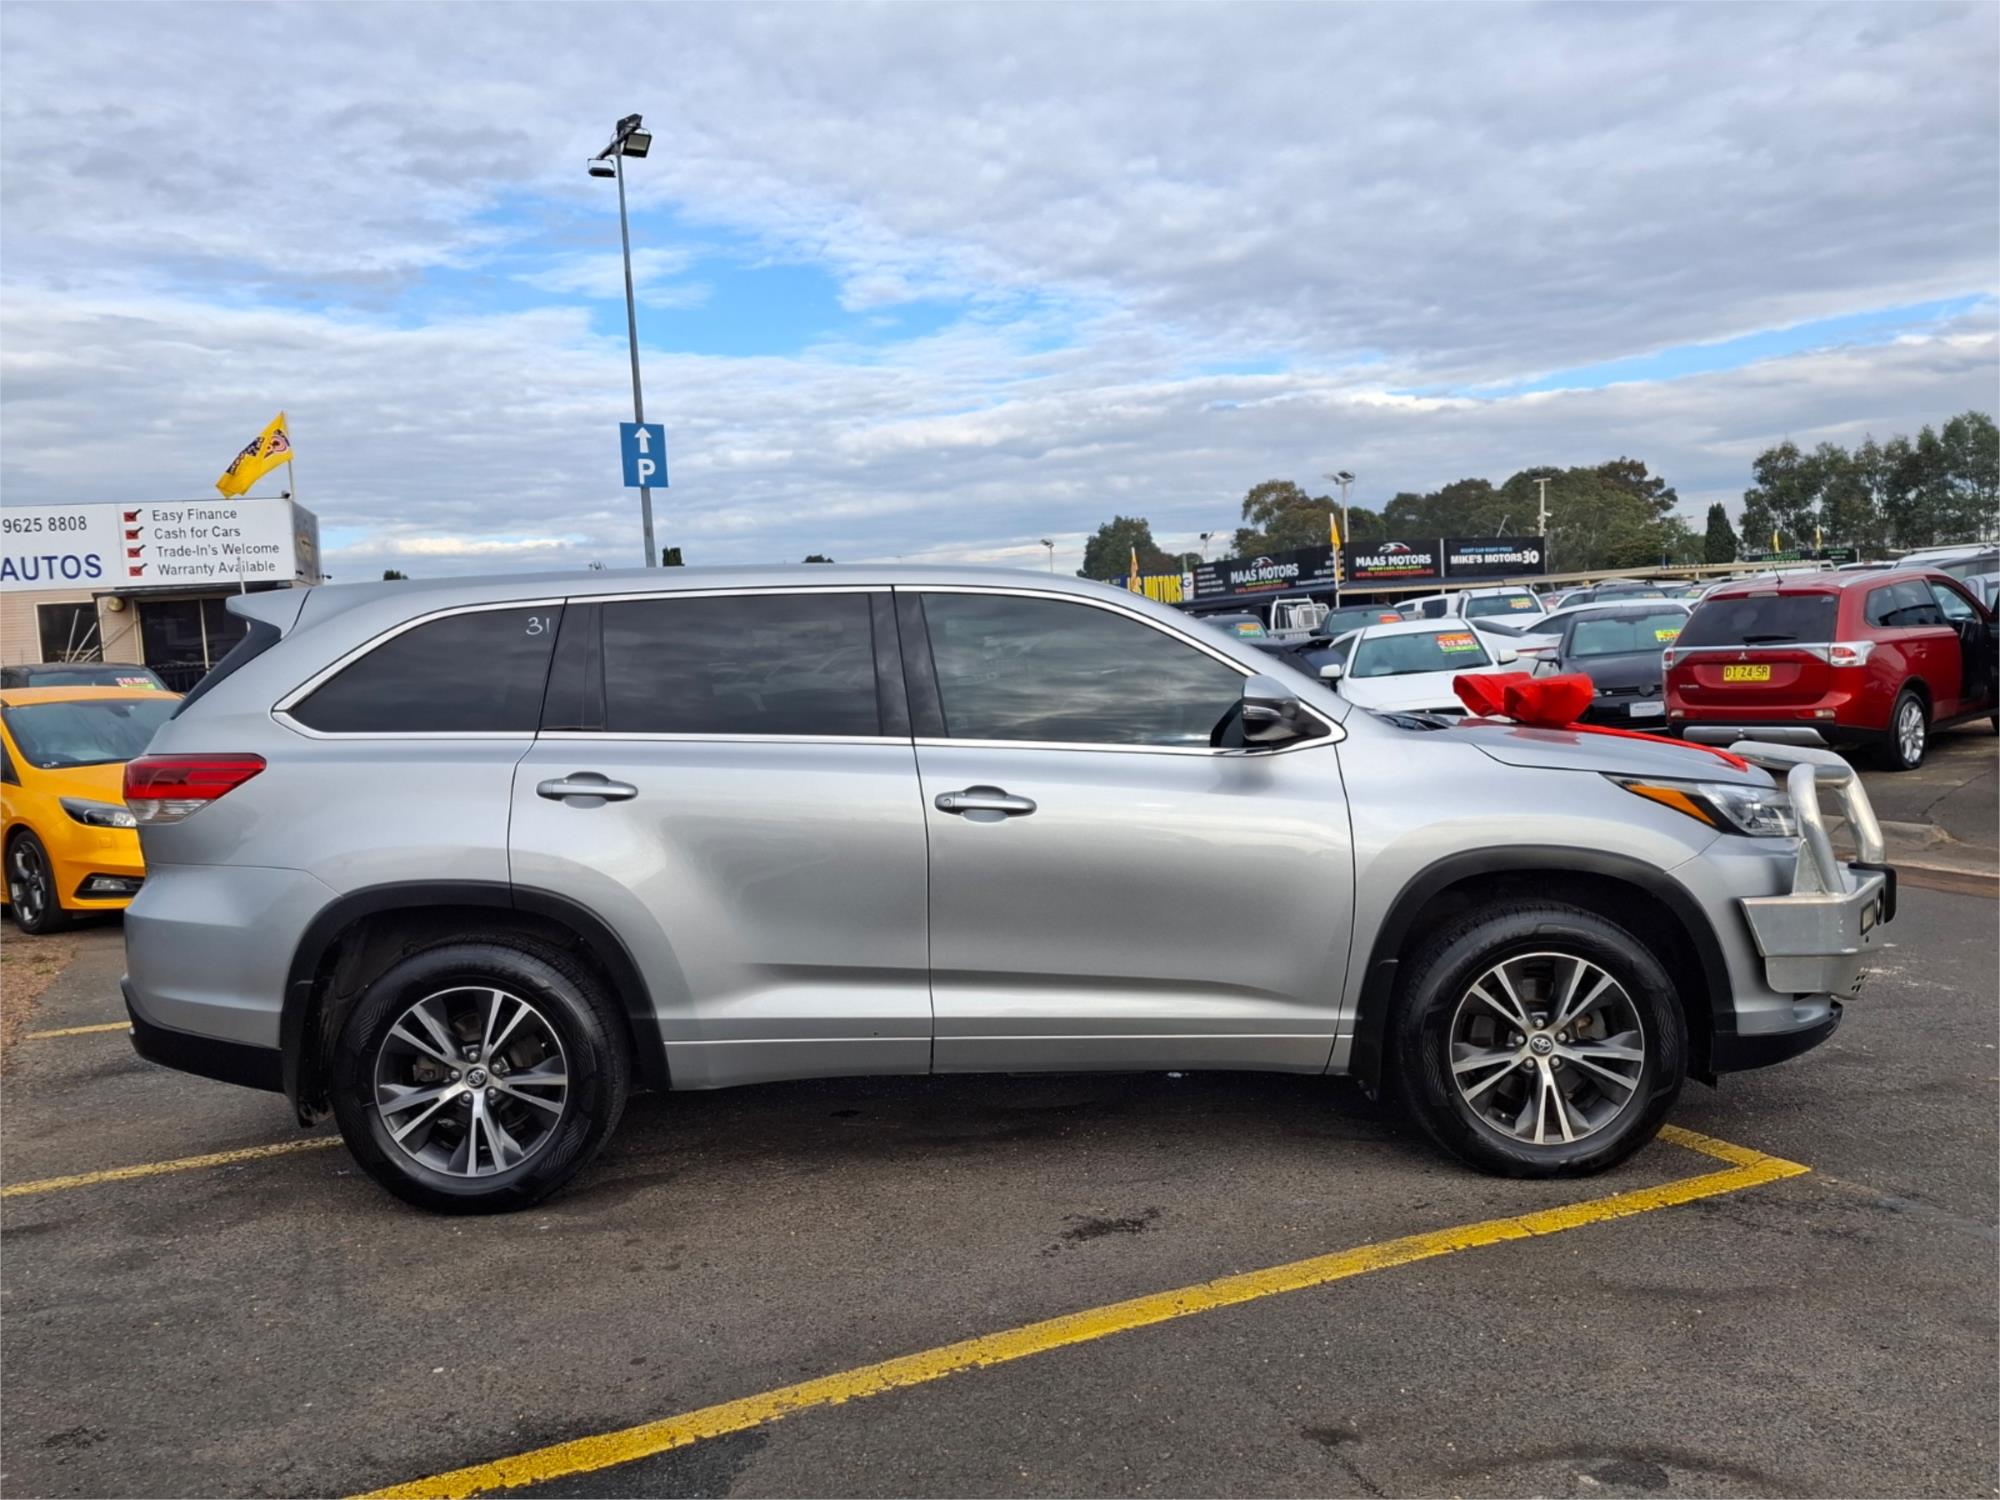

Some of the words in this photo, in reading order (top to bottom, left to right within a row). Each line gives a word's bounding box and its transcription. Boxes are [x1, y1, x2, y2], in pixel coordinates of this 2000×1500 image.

[637, 458, 656, 485] P
[152, 509, 184, 523] Easy
[187, 507, 238, 520] Finance
[2, 518, 43, 534] 9625
[48, 515, 87, 531] 8808
[154, 527, 187, 540] Cash
[190, 526, 209, 539] for
[211, 525, 241, 537] Cars
[156, 543, 219, 557] Trade-In's
[221, 543, 280, 555] Welcome
[1450, 554, 1483, 565] MIKE'S
[1484, 552, 1522, 563] MOTORS
[1522, 550, 1540, 565] 30
[0, 554, 102, 581] AUTOS
[157, 562, 215, 576] Warranty
[218, 560, 277, 573] Available
[1355, 556, 1386, 568] MAAS
[1388, 553, 1432, 566] MOTORS
[1230, 569, 1257, 584] MAAS
[1258, 563, 1299, 580] MOTORS
[1143, 574, 1183, 604] MOTORS
[526, 616, 550, 635] 31
